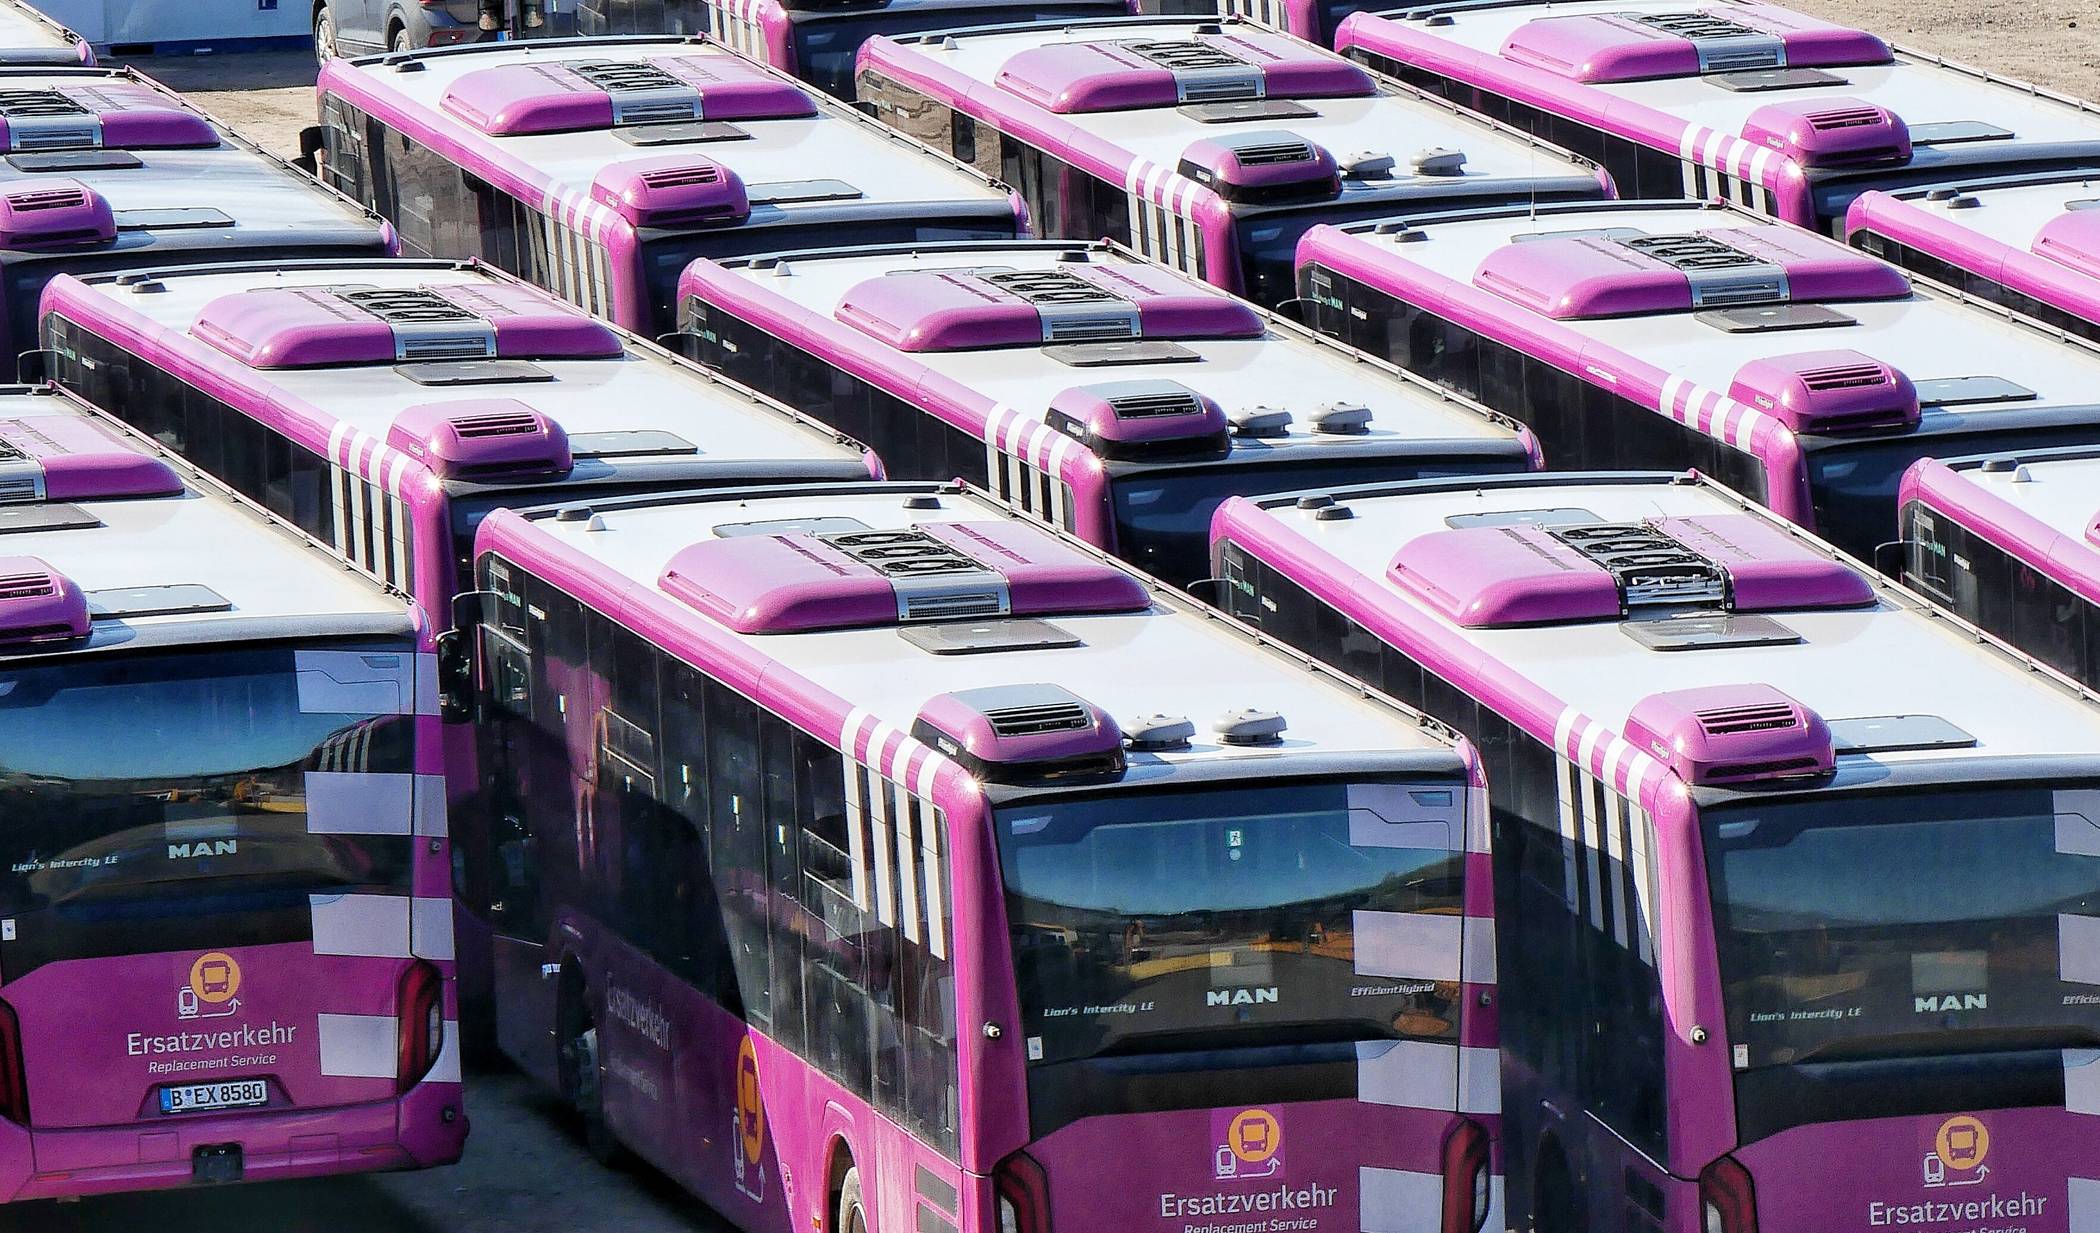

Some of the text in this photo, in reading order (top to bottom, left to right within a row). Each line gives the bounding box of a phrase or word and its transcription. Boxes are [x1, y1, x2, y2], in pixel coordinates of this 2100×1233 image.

[168, 839, 237, 859] MAN
[12, 855, 119, 872] Lion's Intercity LE
[1206, 987, 1279, 1007] MAN
[1351, 983, 1436, 997] EfficientHybrid
[1043, 1001, 1156, 1018] Lion's Intercity LE
[1915, 993, 1988, 1013] MAN
[1750, 1007, 1862, 1022] Lion's Intercity LE
[127, 1020, 297, 1056] Ersatzverkehr
[148, 1053, 277, 1075] Replacement Service
[171, 1089, 183, 1107] B
[220, 1083, 263, 1103] 8580
[1160, 1182, 1338, 1218] Ersatzverkehr
[1869, 1191, 2048, 1226] Ersatzverkehr
[1270, 1216, 1318, 1231] Service
